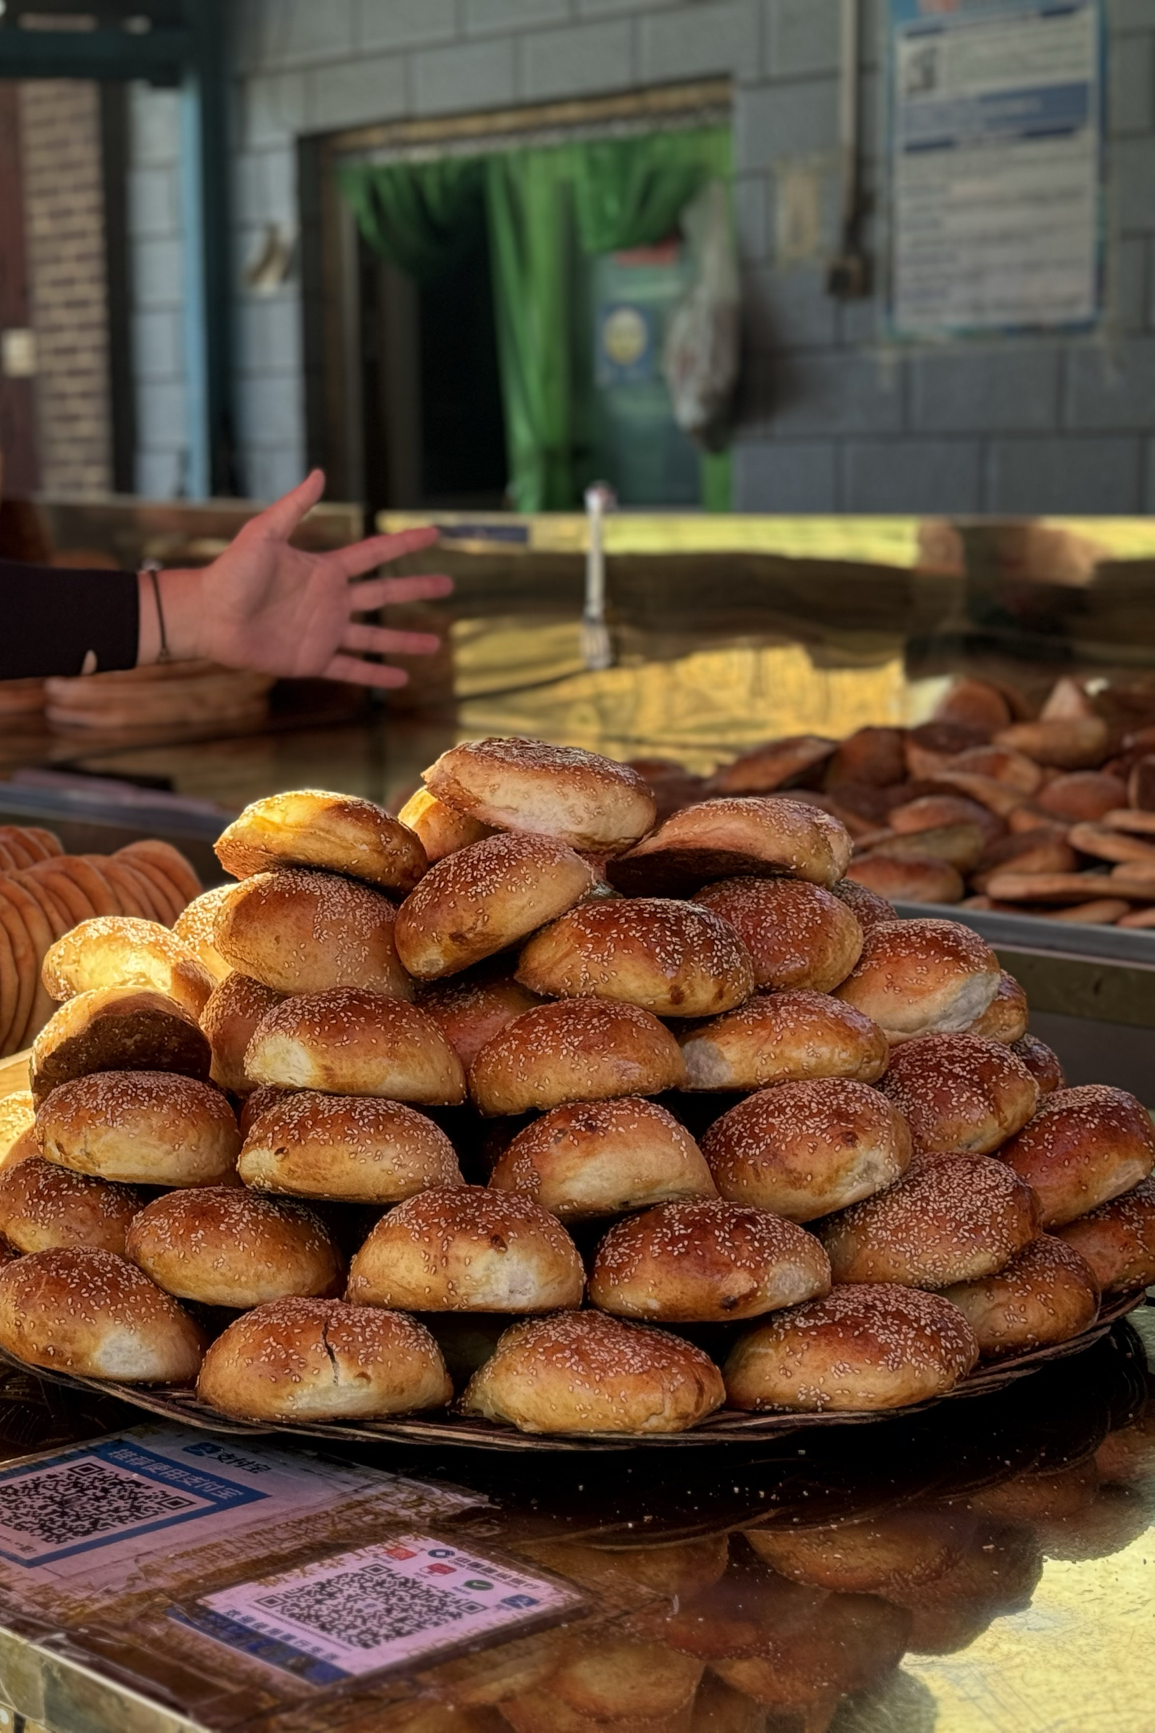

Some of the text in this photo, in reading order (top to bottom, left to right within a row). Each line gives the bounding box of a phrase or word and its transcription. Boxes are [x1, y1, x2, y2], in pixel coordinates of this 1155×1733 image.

[107, 1447, 244, 1500] 推荐使用支付宝
[208, 1448, 272, 1474] 支付宝
